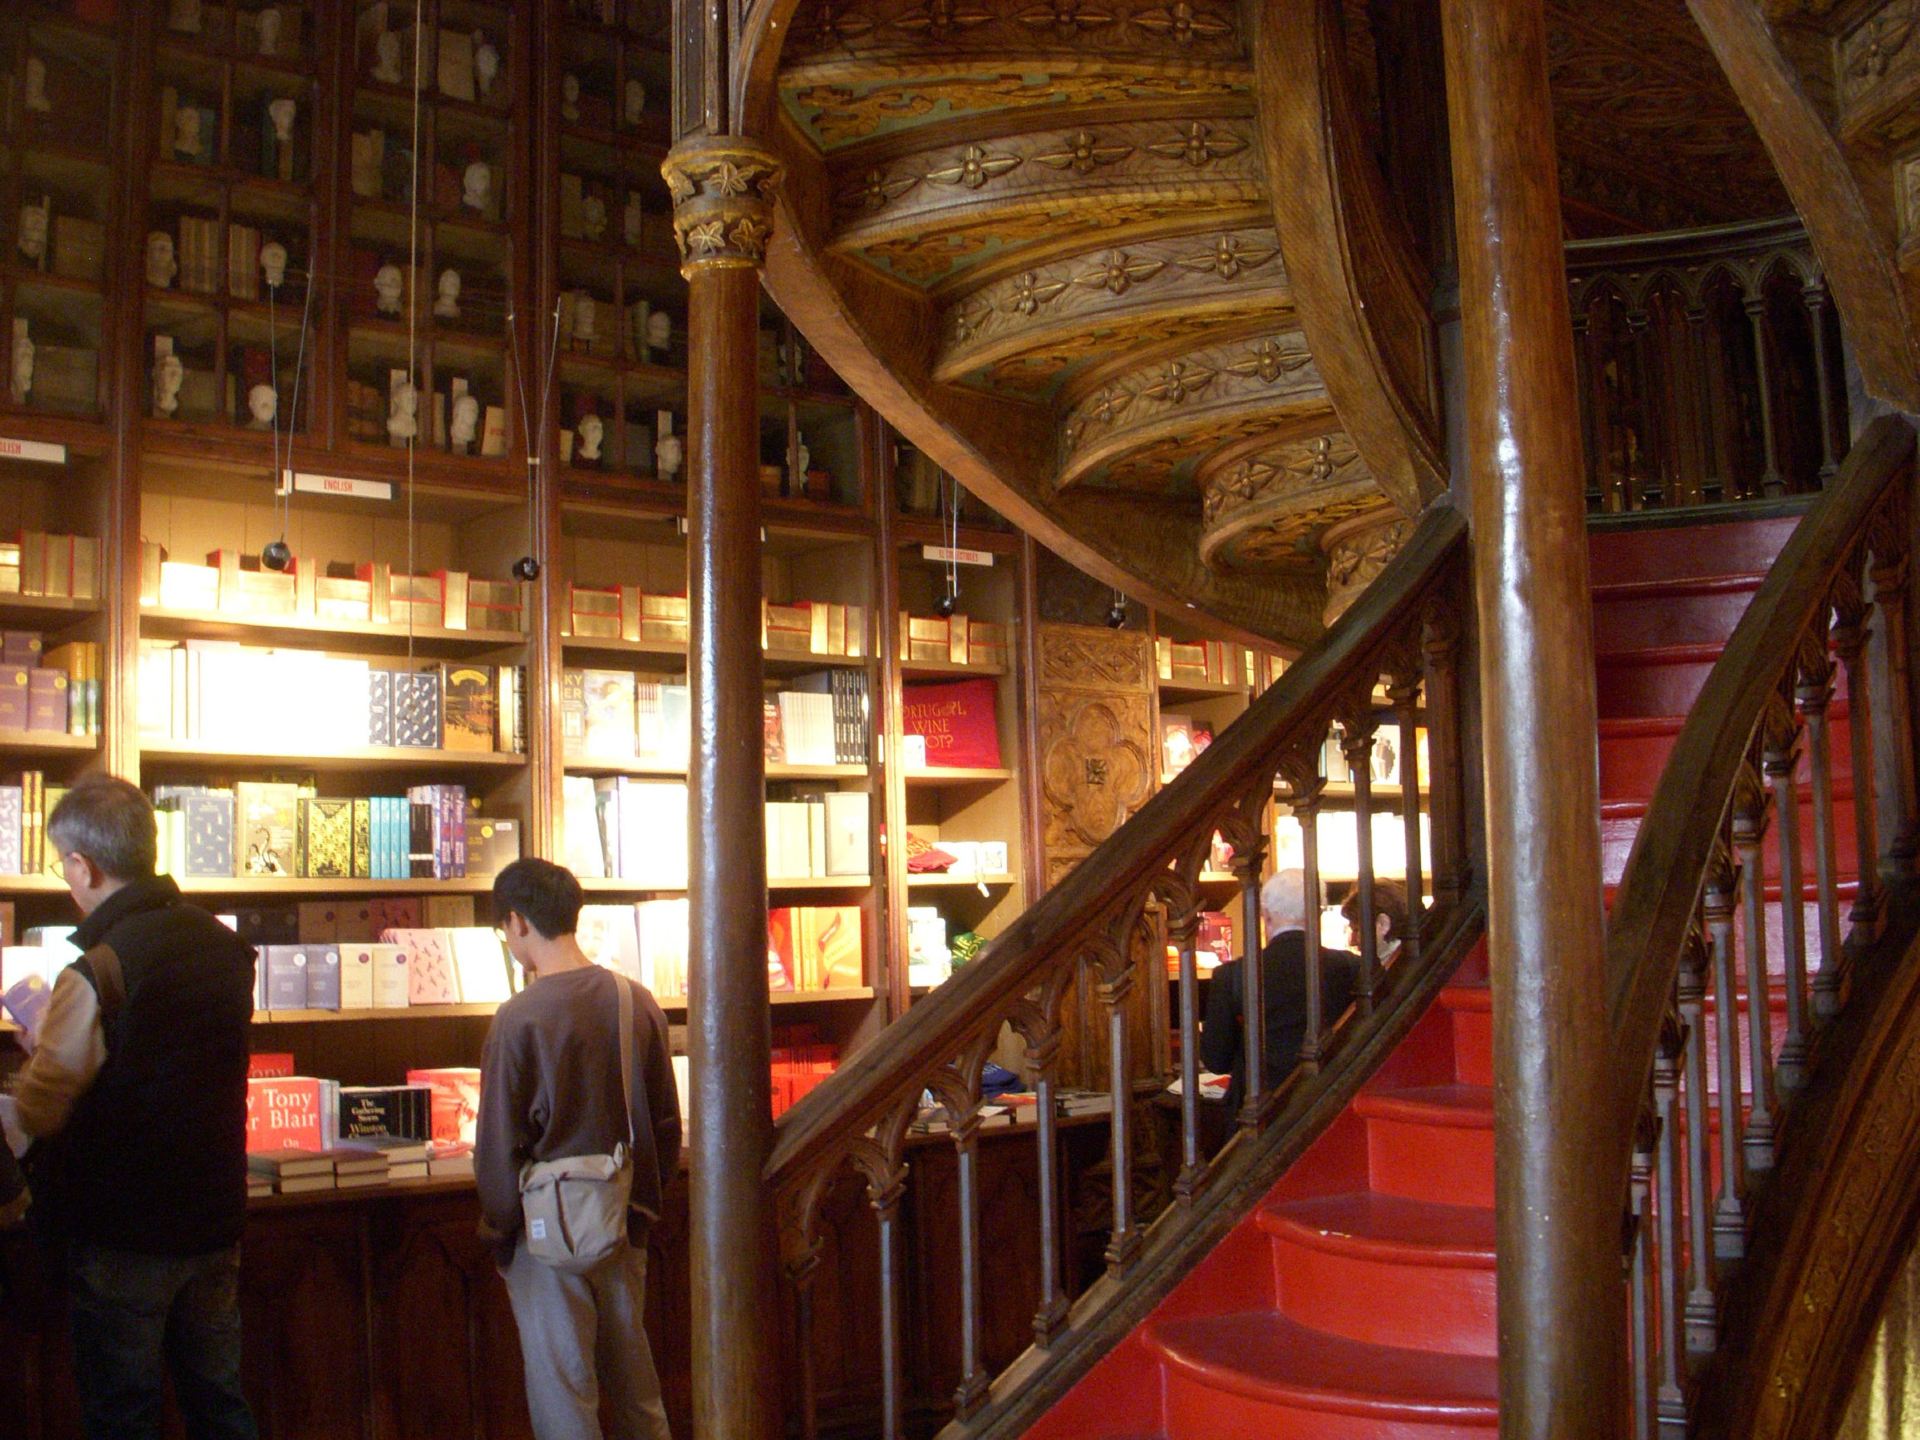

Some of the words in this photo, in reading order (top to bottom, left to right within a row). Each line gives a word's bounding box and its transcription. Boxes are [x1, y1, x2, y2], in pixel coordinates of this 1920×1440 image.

[323, 479, 353, 493] ENGLISH
[912, 718, 950, 735] WINE
[925, 734, 954, 749] OT?
[263, 1088, 312, 1114] Tony
[269, 1109, 318, 1130] Blair
